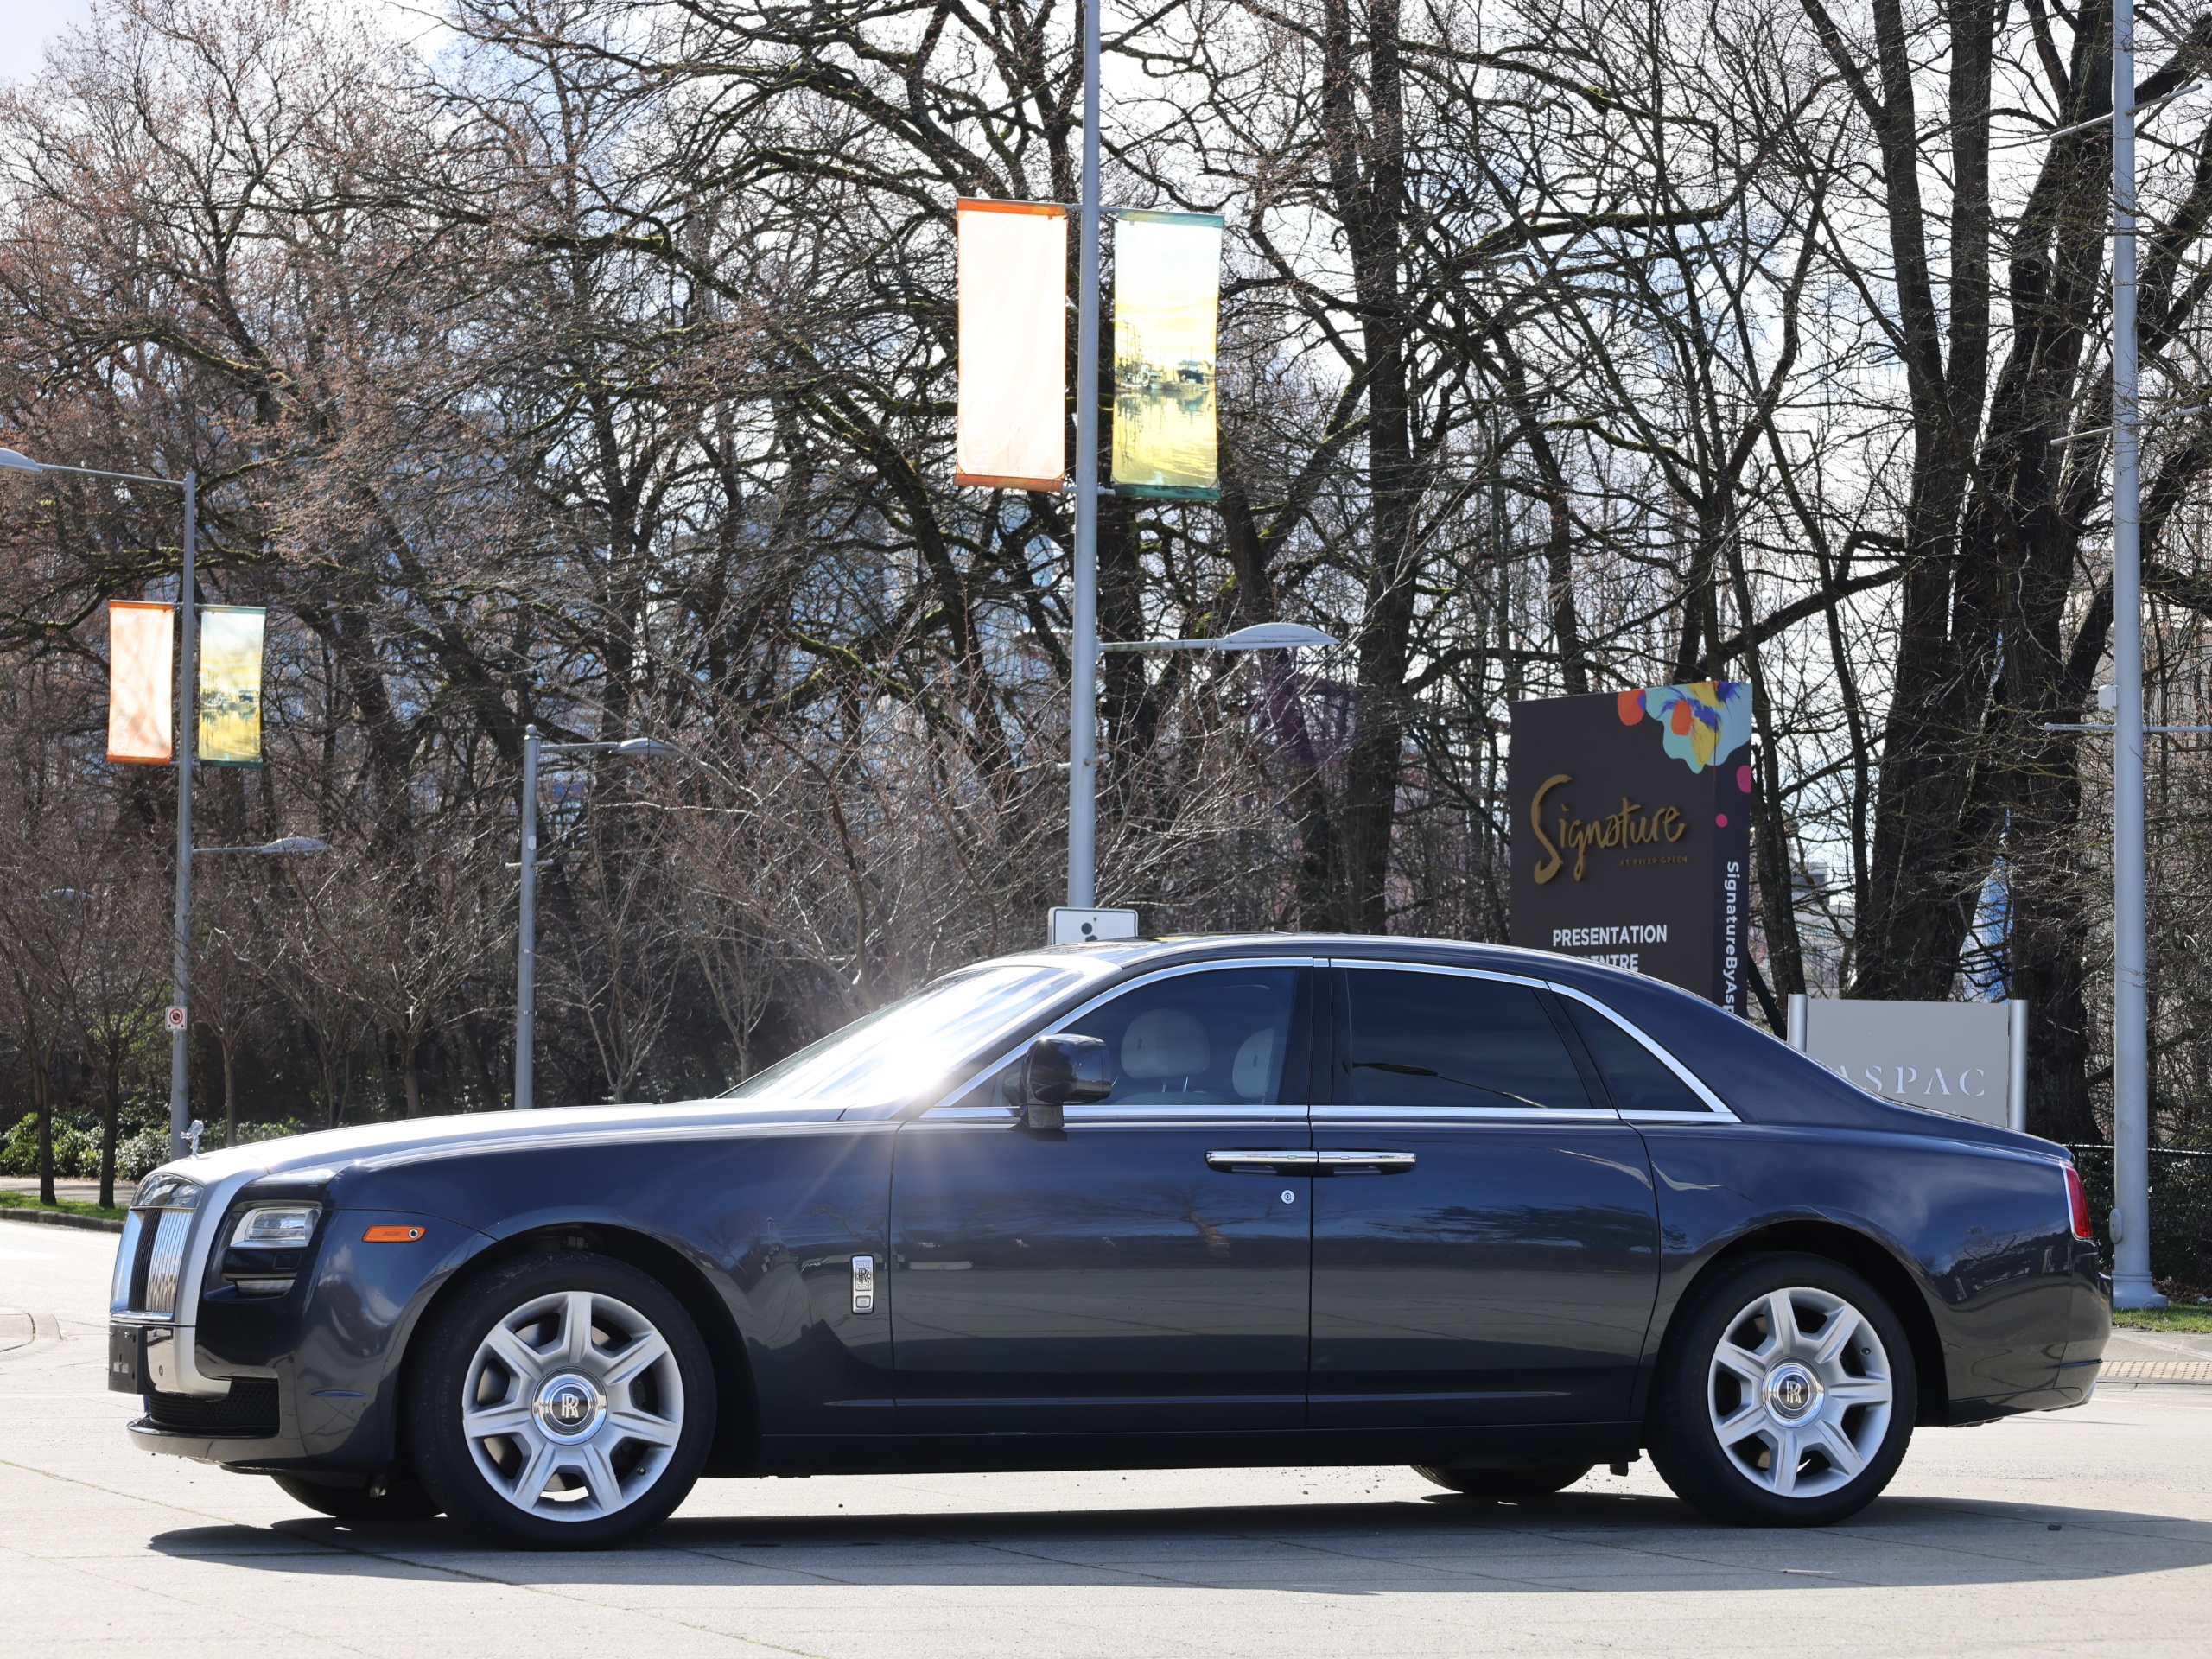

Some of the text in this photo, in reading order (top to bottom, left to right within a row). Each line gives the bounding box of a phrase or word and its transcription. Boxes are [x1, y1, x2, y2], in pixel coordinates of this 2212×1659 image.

[1530, 774, 1688, 884] Signature
[1661, 855, 1688, 864] GREEN
[1553, 925, 1668, 947] PRESENTATION
[1578, 953, 1639, 972] NTRE
[1840, 1065, 1985, 1096] SPAC
[1786, 1380, 1802, 1404] RR
[561, 1393, 580, 1418] RR
